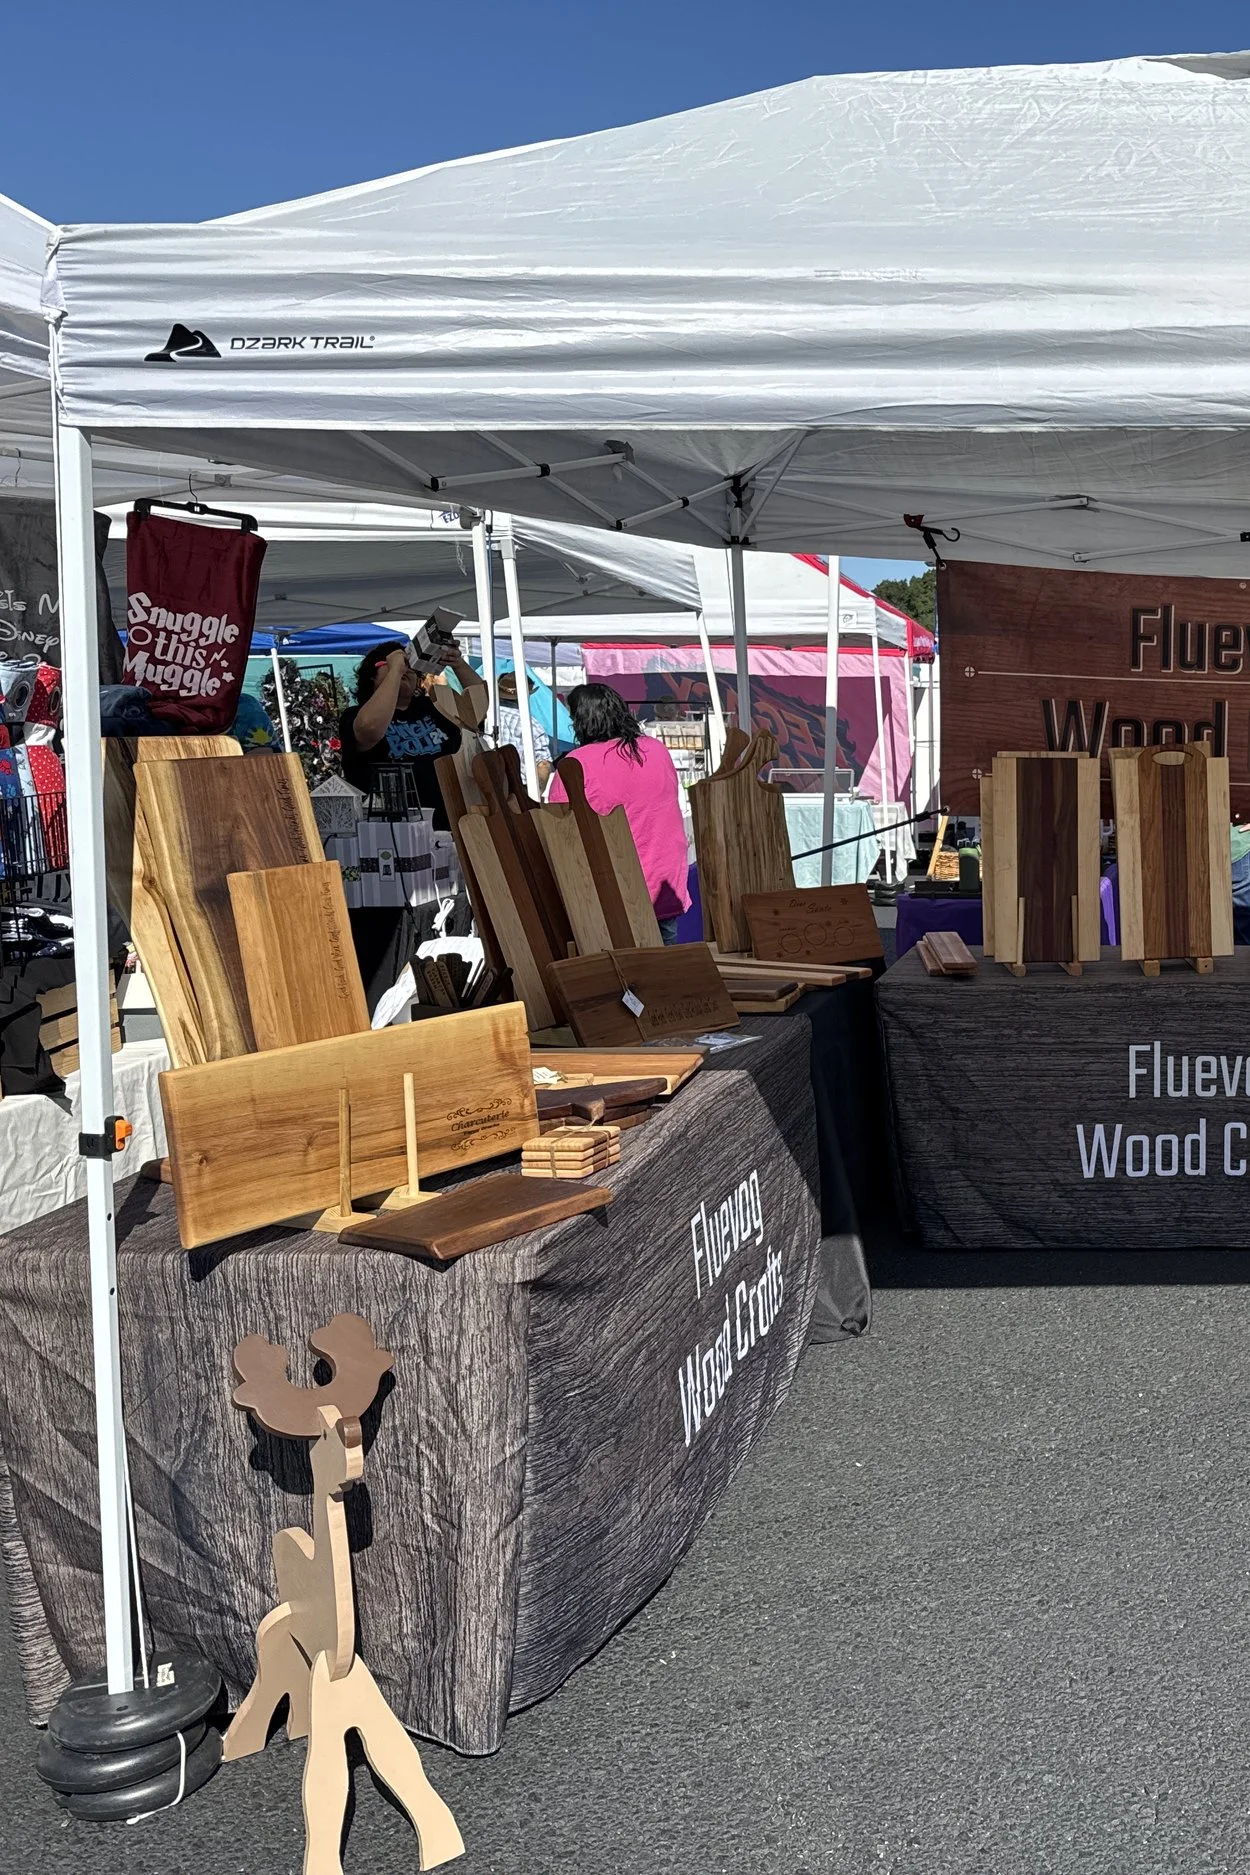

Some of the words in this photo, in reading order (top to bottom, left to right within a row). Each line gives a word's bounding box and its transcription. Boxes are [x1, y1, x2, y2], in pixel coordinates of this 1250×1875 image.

[230, 335, 307, 350] OZARK
[128, 592, 240, 647] Snuggle
[122, 650, 221, 698] Muggle
[155, 631, 207, 669] this
[451, 1110, 510, 1132] Charcuterie
[1076, 1117, 1206, 1179] Wood
[690, 1169, 764, 1300] Fluevog
[678, 1292, 733, 1448] Wood
[735, 1244, 784, 1361] Crafts
